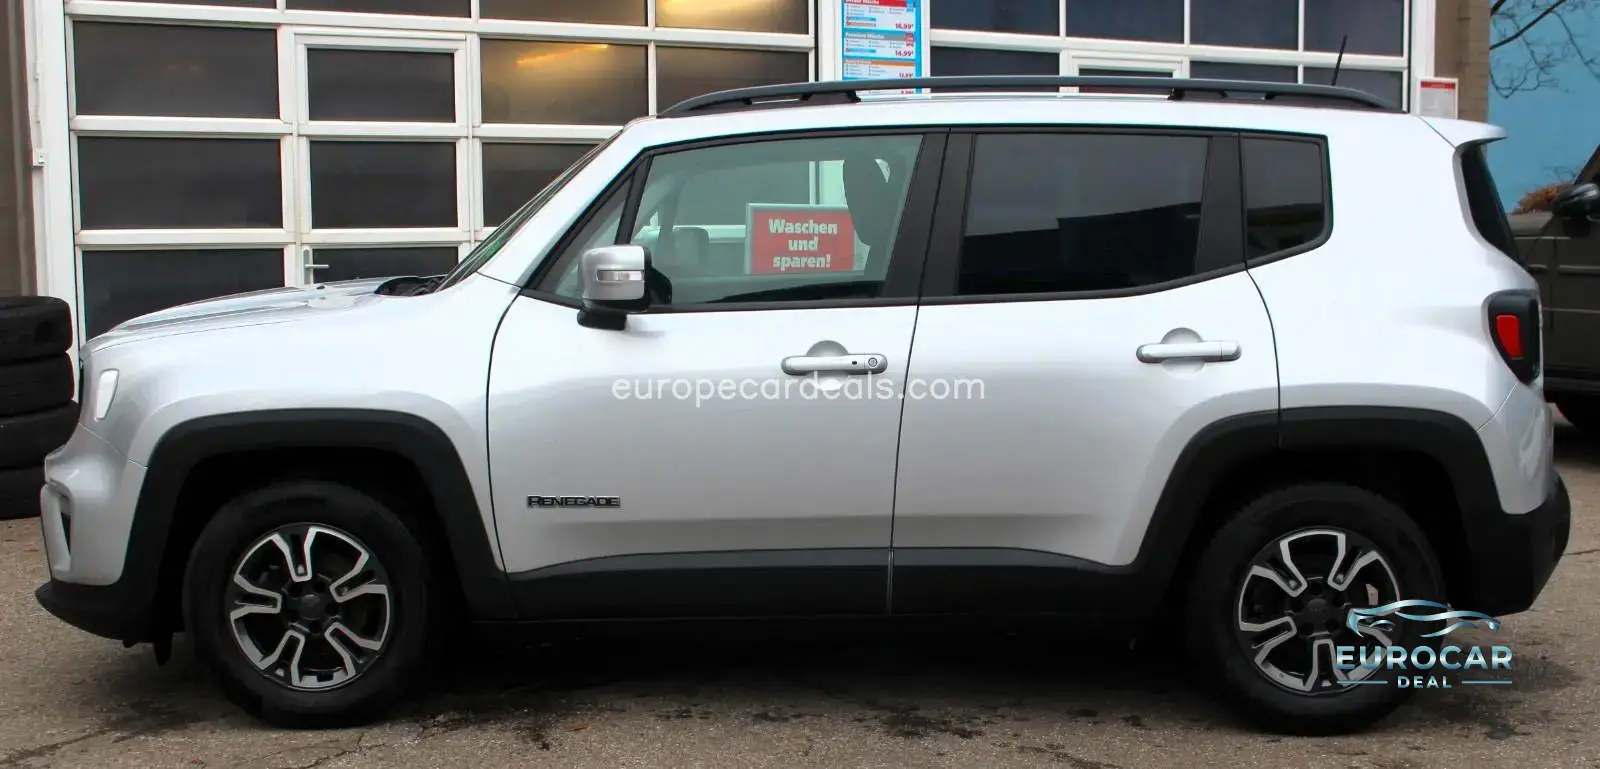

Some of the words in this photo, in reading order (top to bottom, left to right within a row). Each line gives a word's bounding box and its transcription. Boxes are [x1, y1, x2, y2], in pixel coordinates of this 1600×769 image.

[768, 218, 838, 235] Waschen
[788, 236, 818, 251] und
[772, 253, 832, 272] sparen!
[527, 495, 621, 508] RENEGADE
